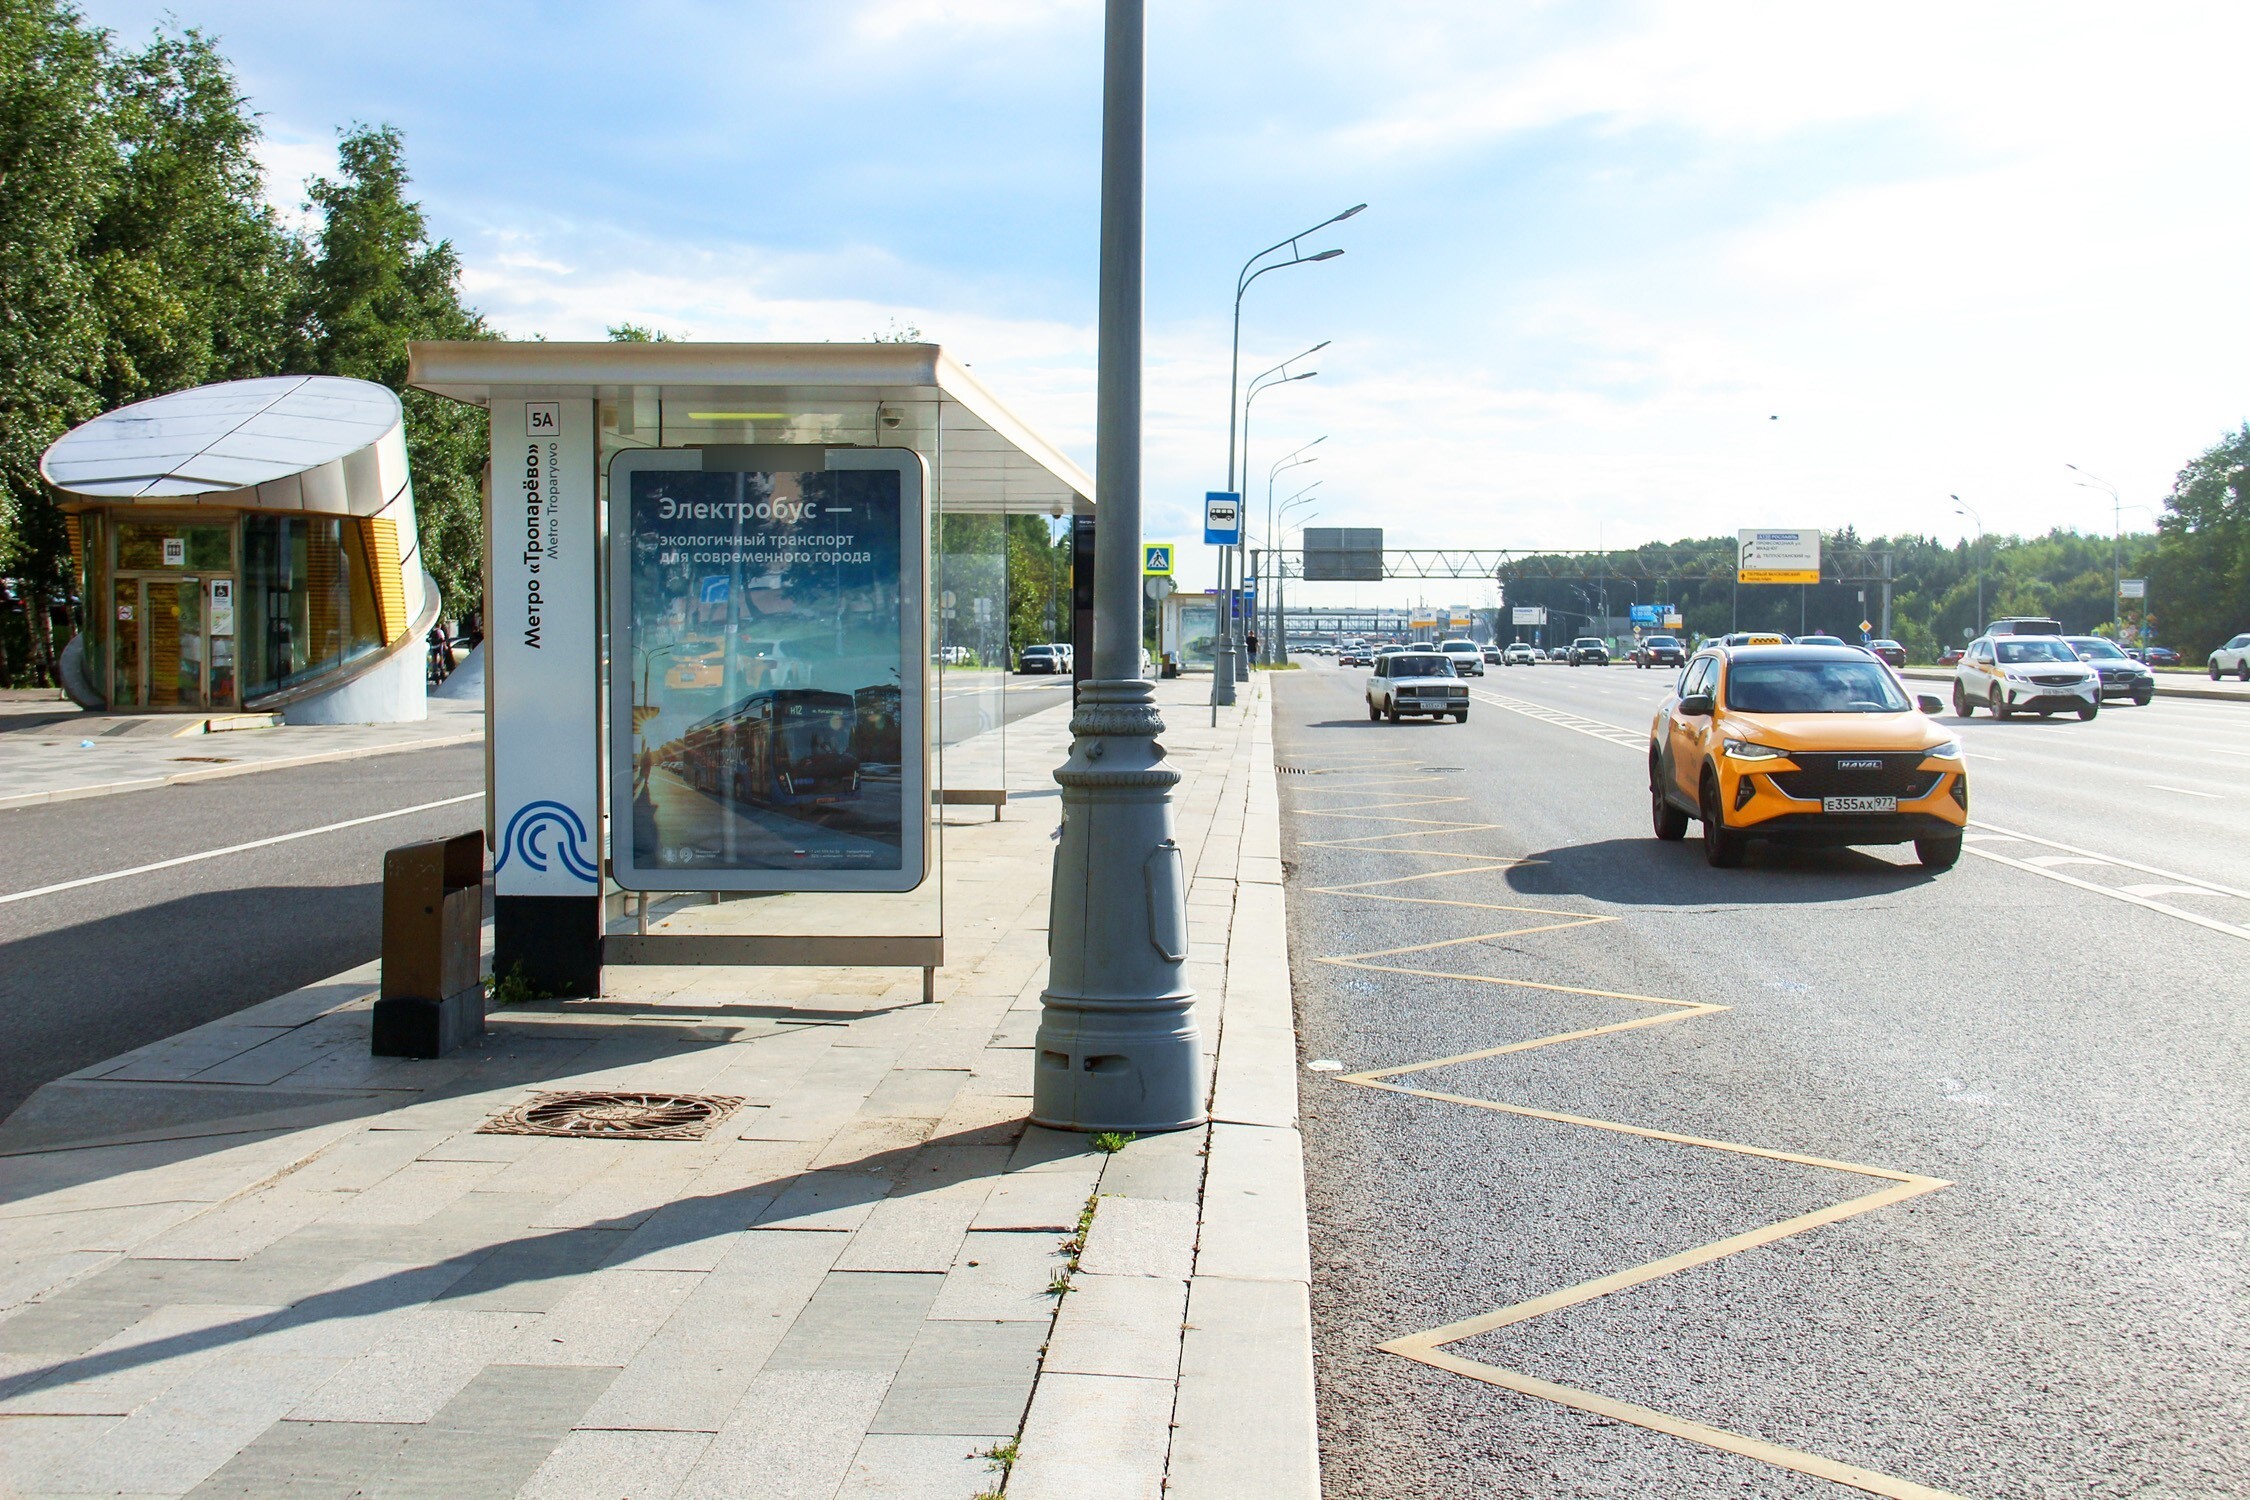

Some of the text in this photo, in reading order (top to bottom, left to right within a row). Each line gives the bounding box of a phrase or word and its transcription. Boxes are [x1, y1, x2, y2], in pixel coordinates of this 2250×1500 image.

[547, 442, 560, 560] Metro Troparyovo
[658, 496, 817, 525] Электробус
[523, 443, 544, 649] Метро «Тропарёво»
[659, 532, 854, 549] экологичный транспорт
[659, 552, 871, 565] для современного города
[1875, 797, 1893, 807] 977
